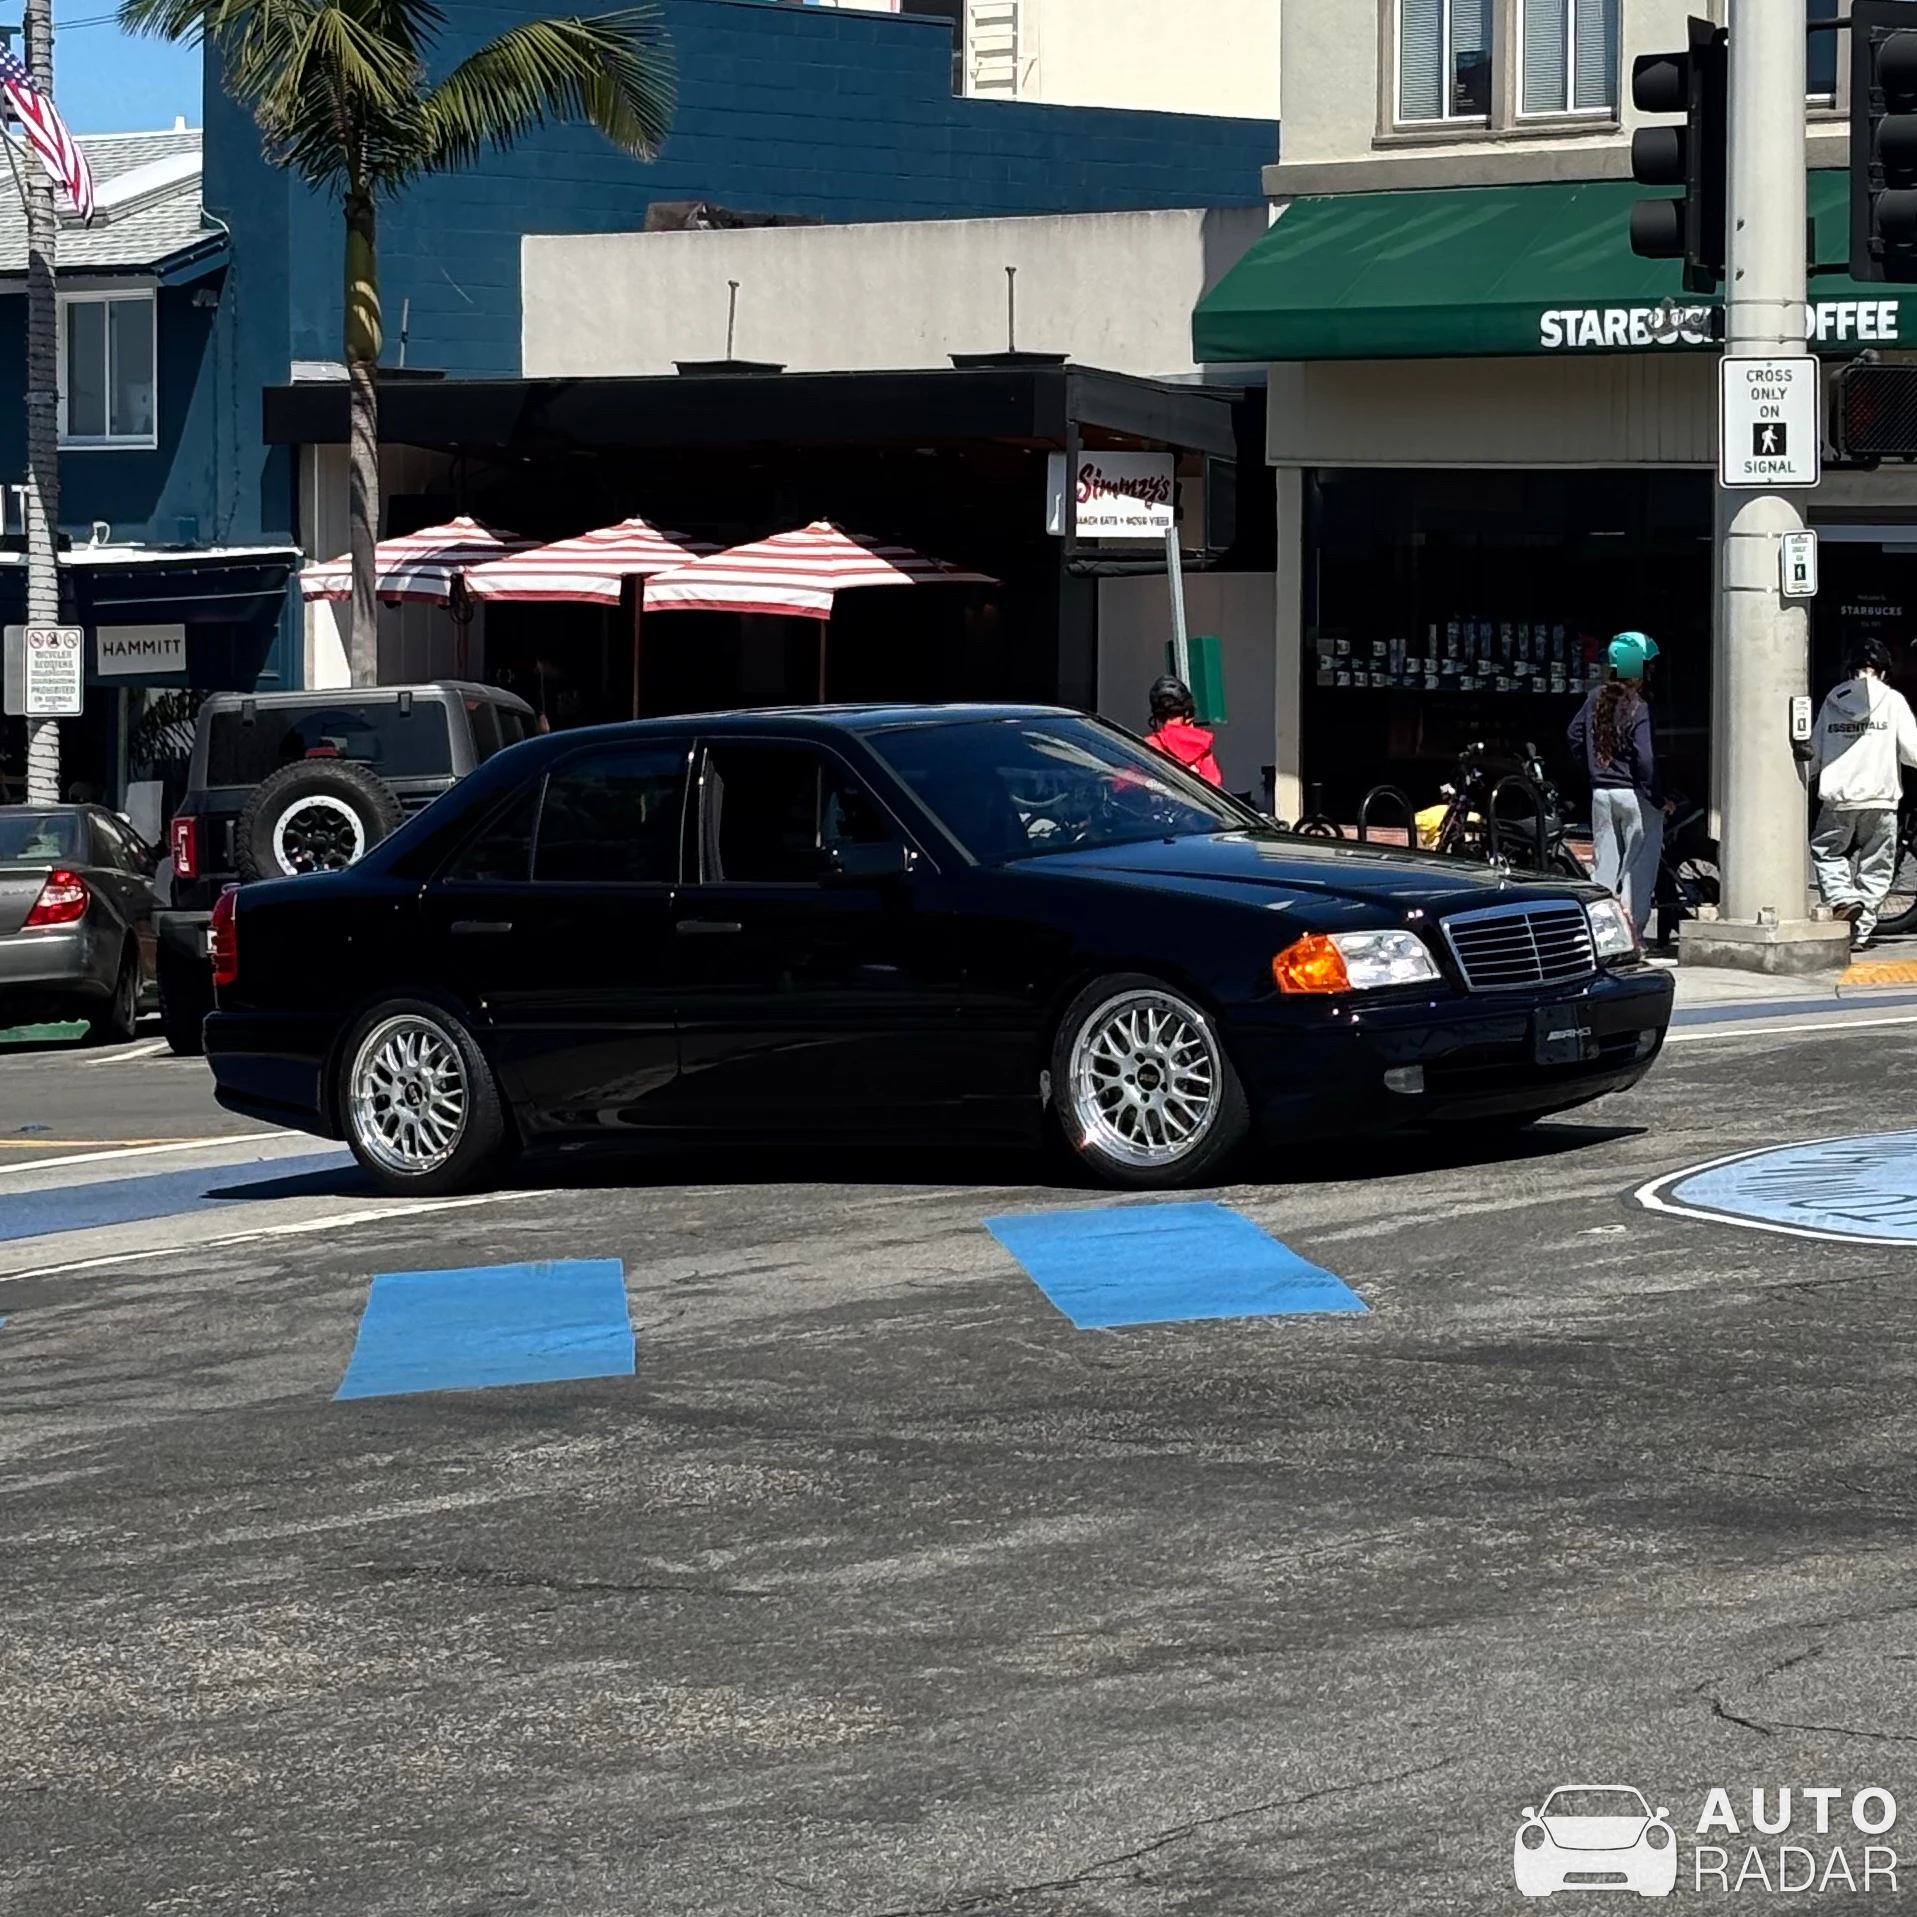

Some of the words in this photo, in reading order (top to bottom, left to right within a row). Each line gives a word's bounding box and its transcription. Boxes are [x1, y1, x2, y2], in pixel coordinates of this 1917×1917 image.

[1746, 369, 1793, 383] CROSS
[1751, 387, 1788, 400] ONLY
[1760, 405, 1780, 418] ON
[1744, 460, 1797, 474] SIGNAL
[1840, 605, 1903, 616] STARBUCKS
[103, 639, 182, 657] HAMMITT
